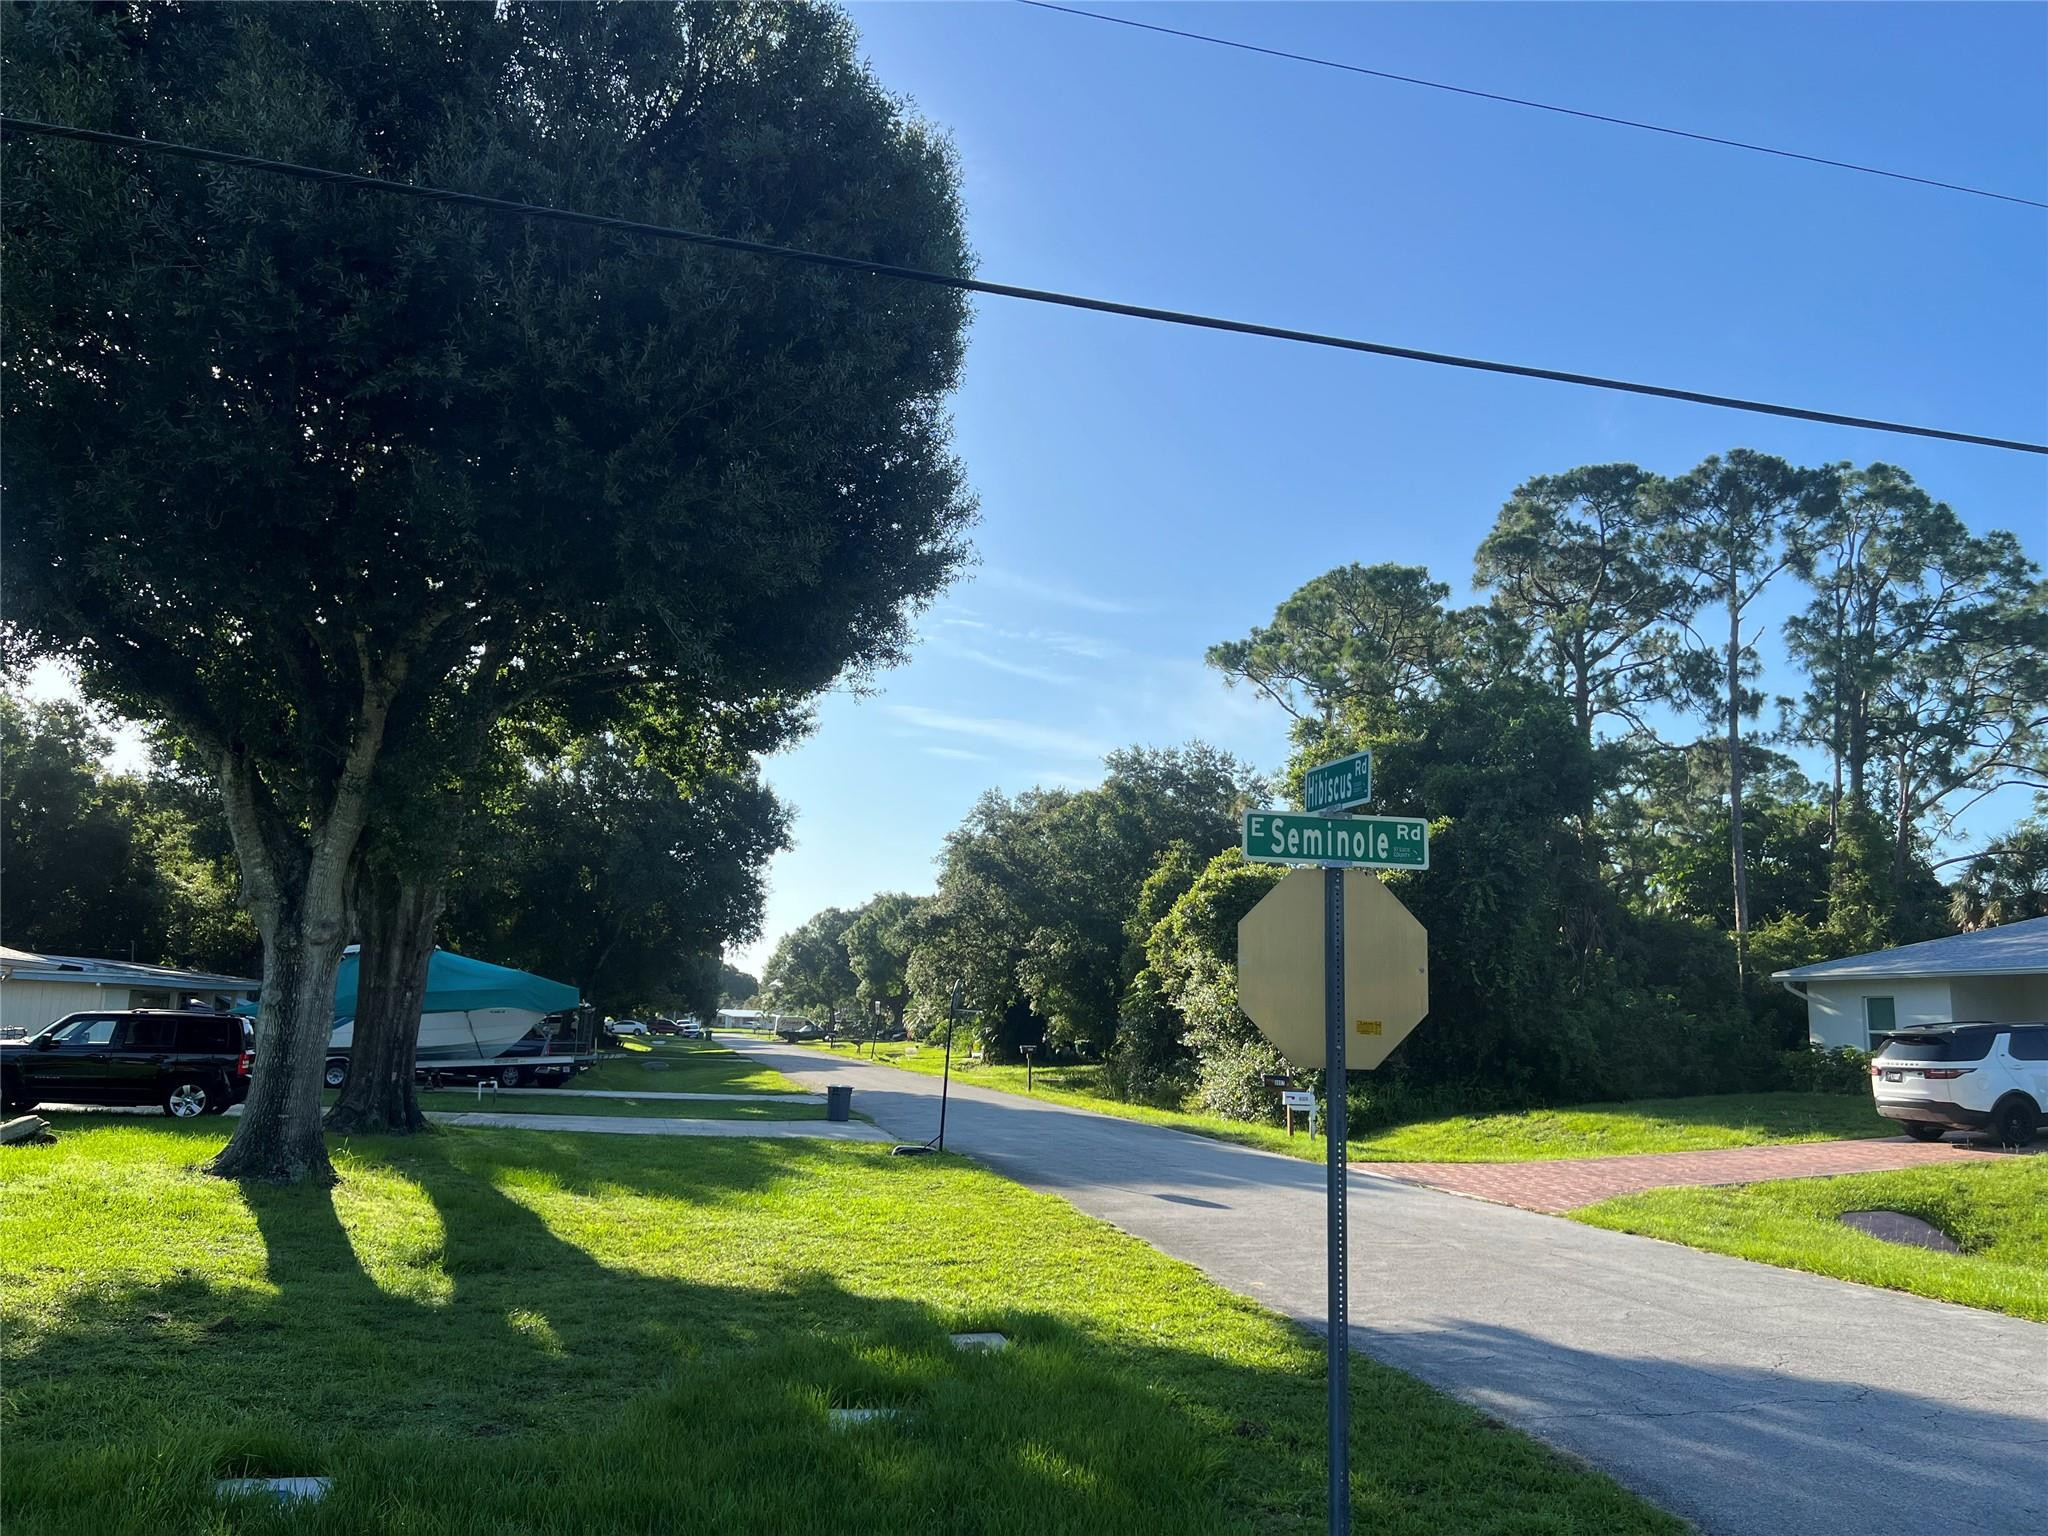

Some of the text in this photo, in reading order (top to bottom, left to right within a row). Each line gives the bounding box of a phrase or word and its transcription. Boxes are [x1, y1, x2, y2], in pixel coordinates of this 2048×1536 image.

[1307, 772, 1352, 808] Hibiscus
[1355, 759, 1367, 777] Rd
[1251, 817, 1265, 836] E
[1270, 817, 1389, 859] Seminole
[1397, 824, 1421, 841] Rd
